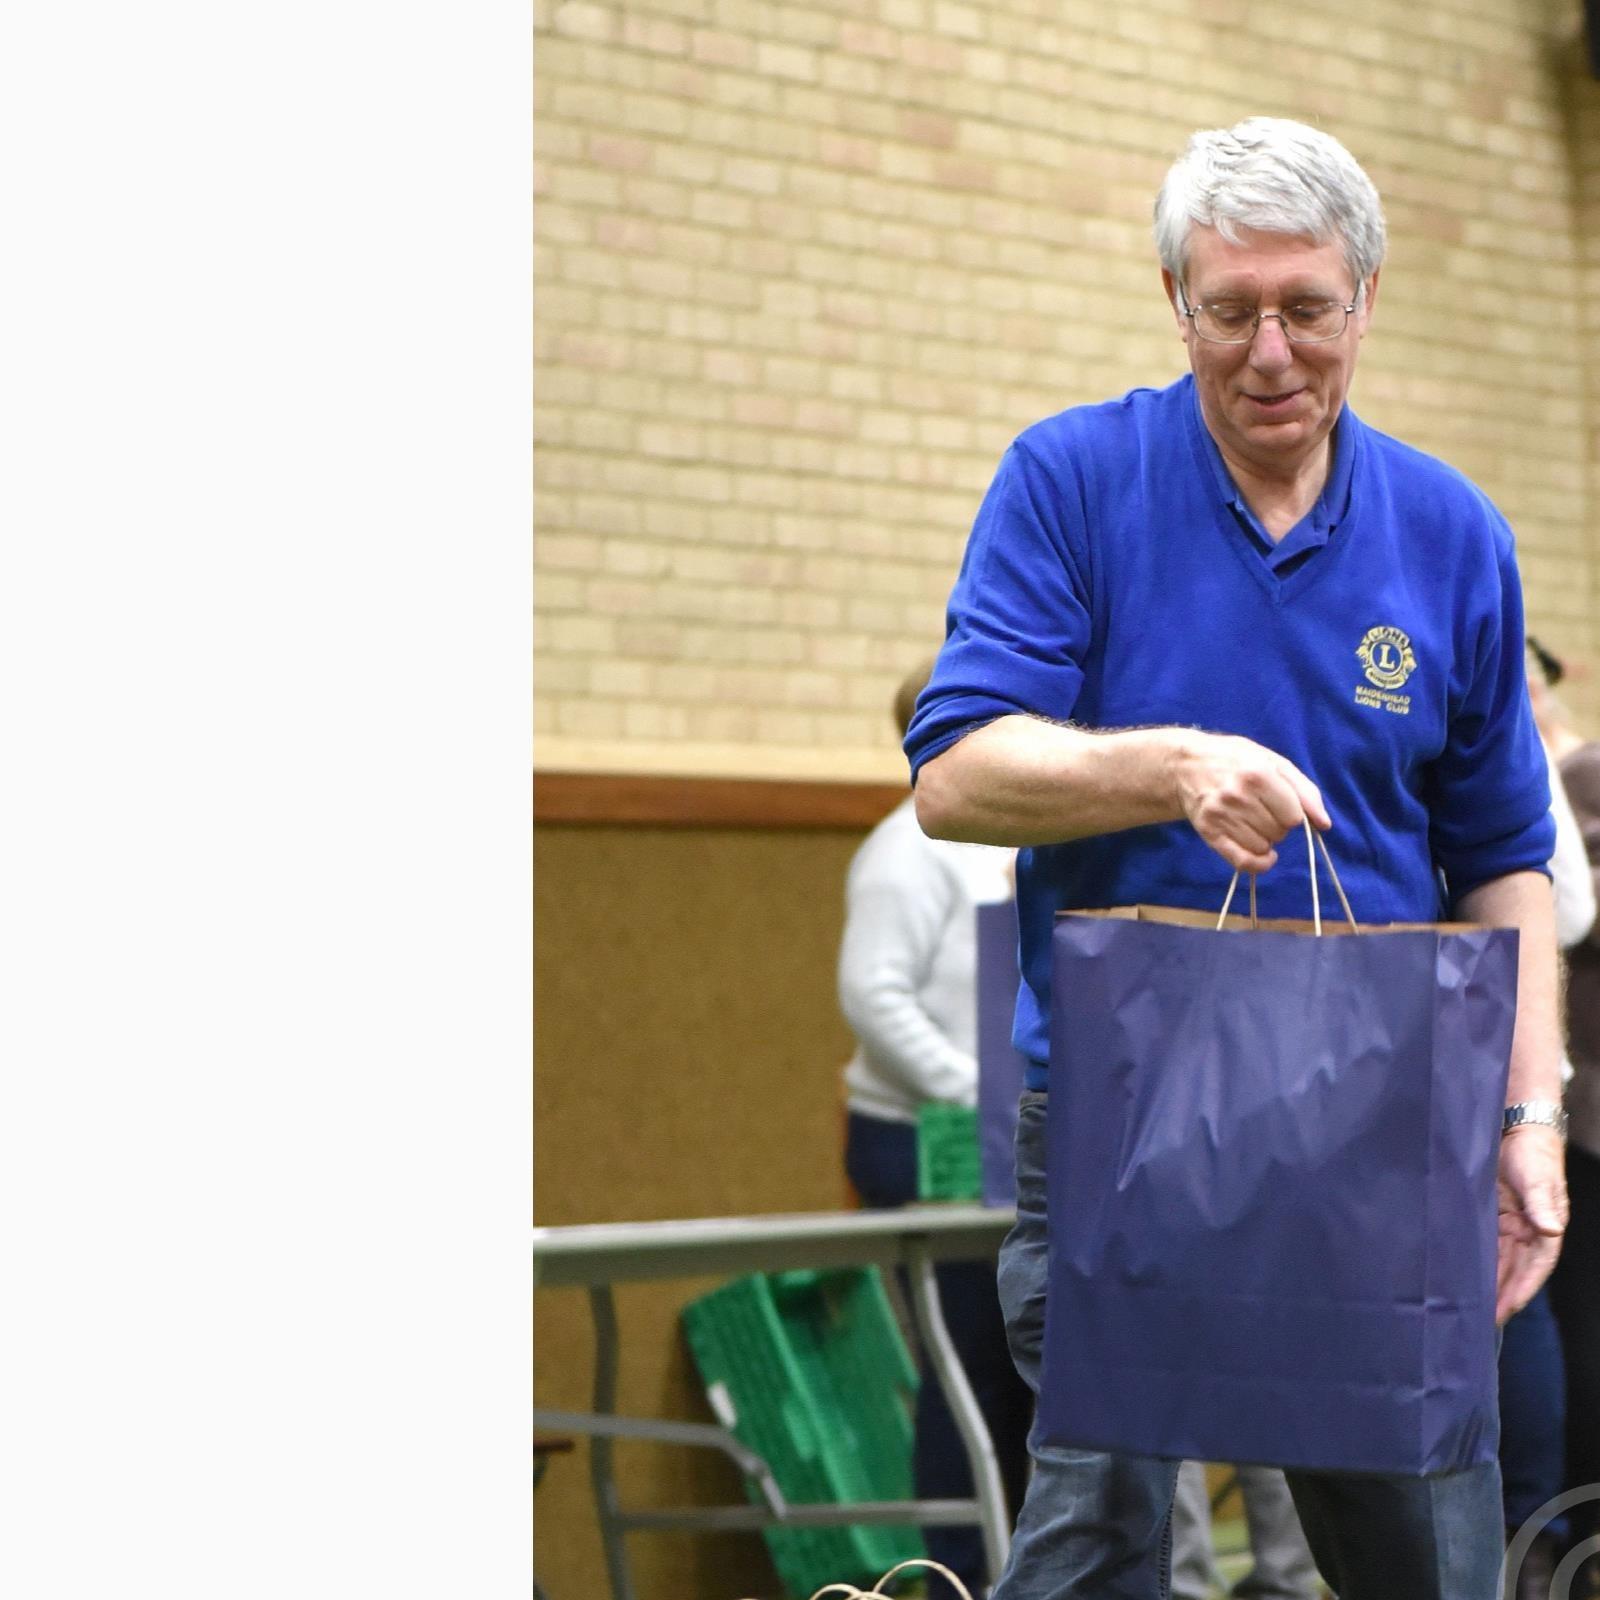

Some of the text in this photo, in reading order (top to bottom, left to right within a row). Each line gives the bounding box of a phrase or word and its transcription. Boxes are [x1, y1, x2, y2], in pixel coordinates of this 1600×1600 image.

[1379, 644, 1395, 669] L
[1354, 695, 1409, 714] LIONS CLUB
